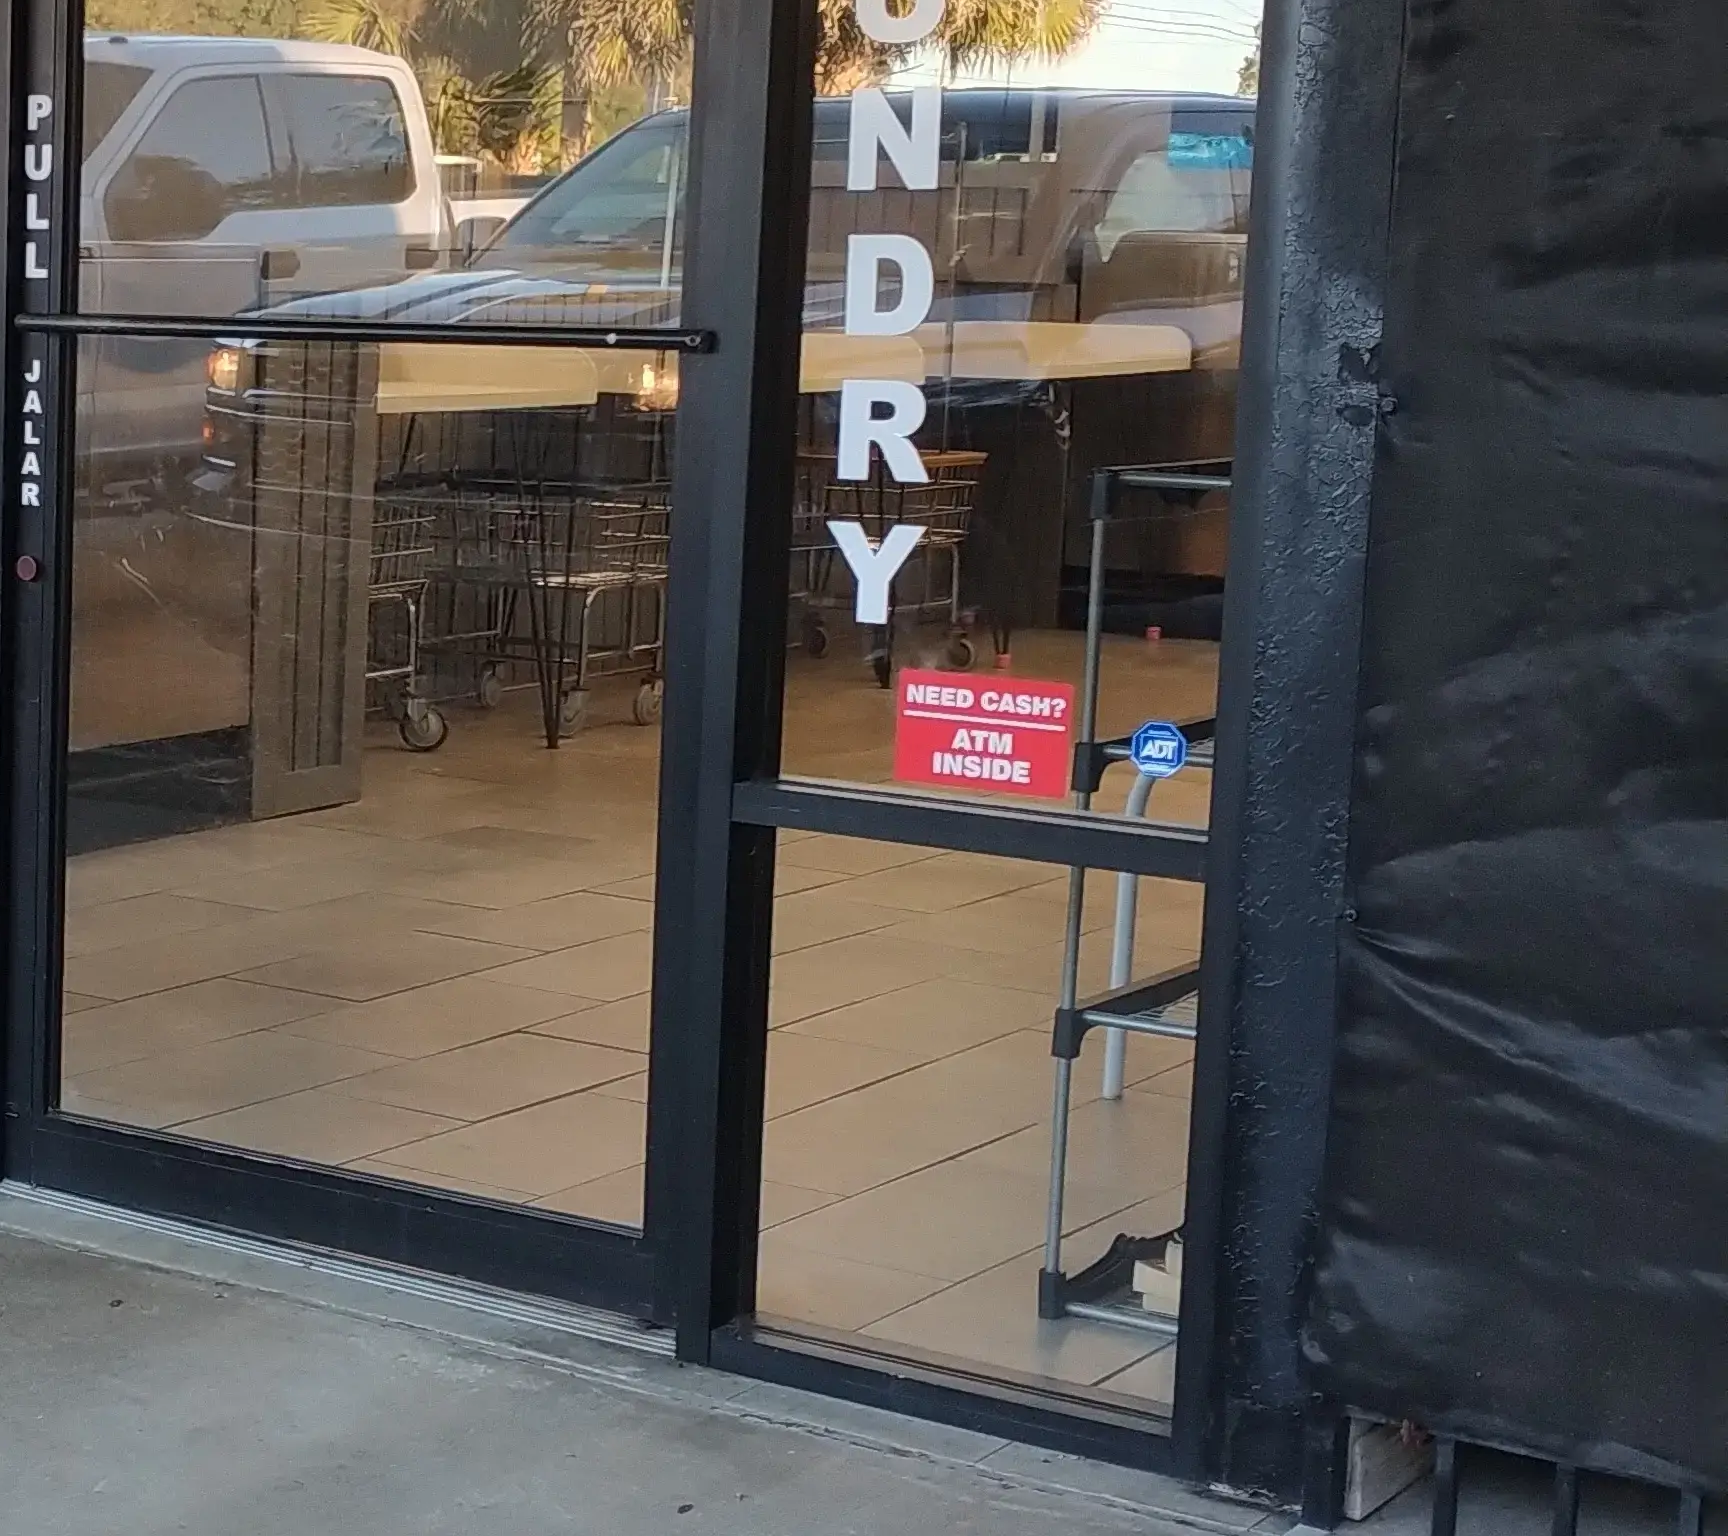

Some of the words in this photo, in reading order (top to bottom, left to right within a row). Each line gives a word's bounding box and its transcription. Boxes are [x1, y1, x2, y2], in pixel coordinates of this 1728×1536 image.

[24, 94, 53, 279] PULL
[20, 359, 44, 507] JALAR
[906, 683, 974, 709] NEED
[980, 691, 1067, 718] CASH?
[950, 728, 1013, 755] ATM
[1139, 739, 1178, 760] ADT
[932, 751, 1032, 784] INSIDE
